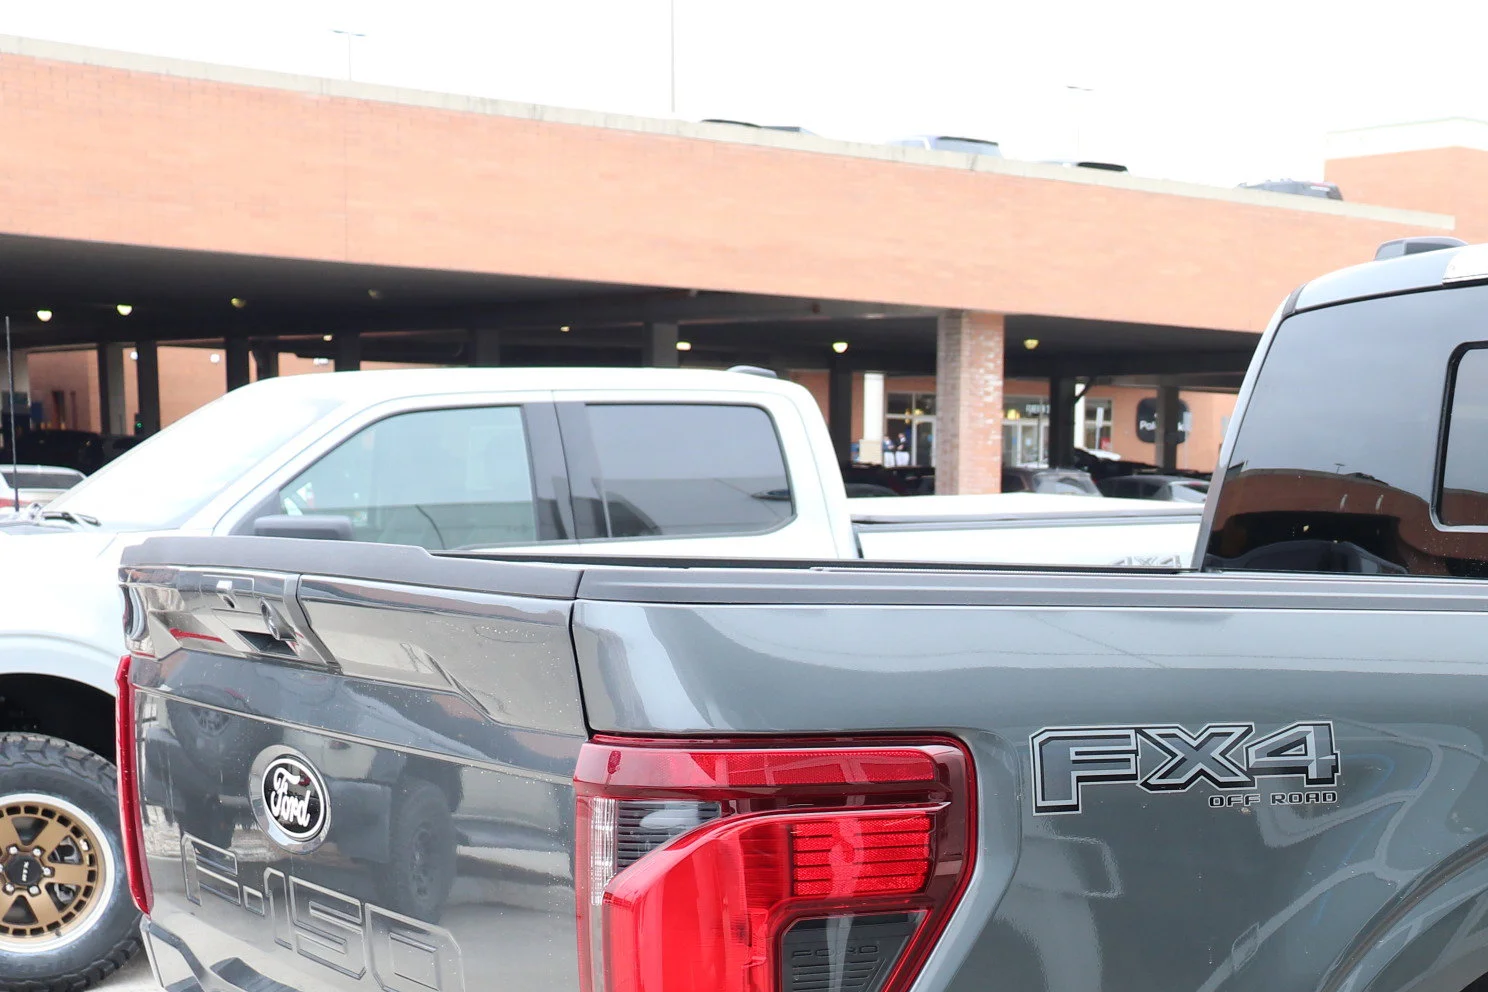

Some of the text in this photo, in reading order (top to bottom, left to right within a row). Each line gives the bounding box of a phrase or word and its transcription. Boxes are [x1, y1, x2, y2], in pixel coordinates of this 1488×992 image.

[271, 766, 312, 827] Ford
[1029, 720, 1341, 817] FX4
[1208, 790, 1338, 808] OFF ROAD
